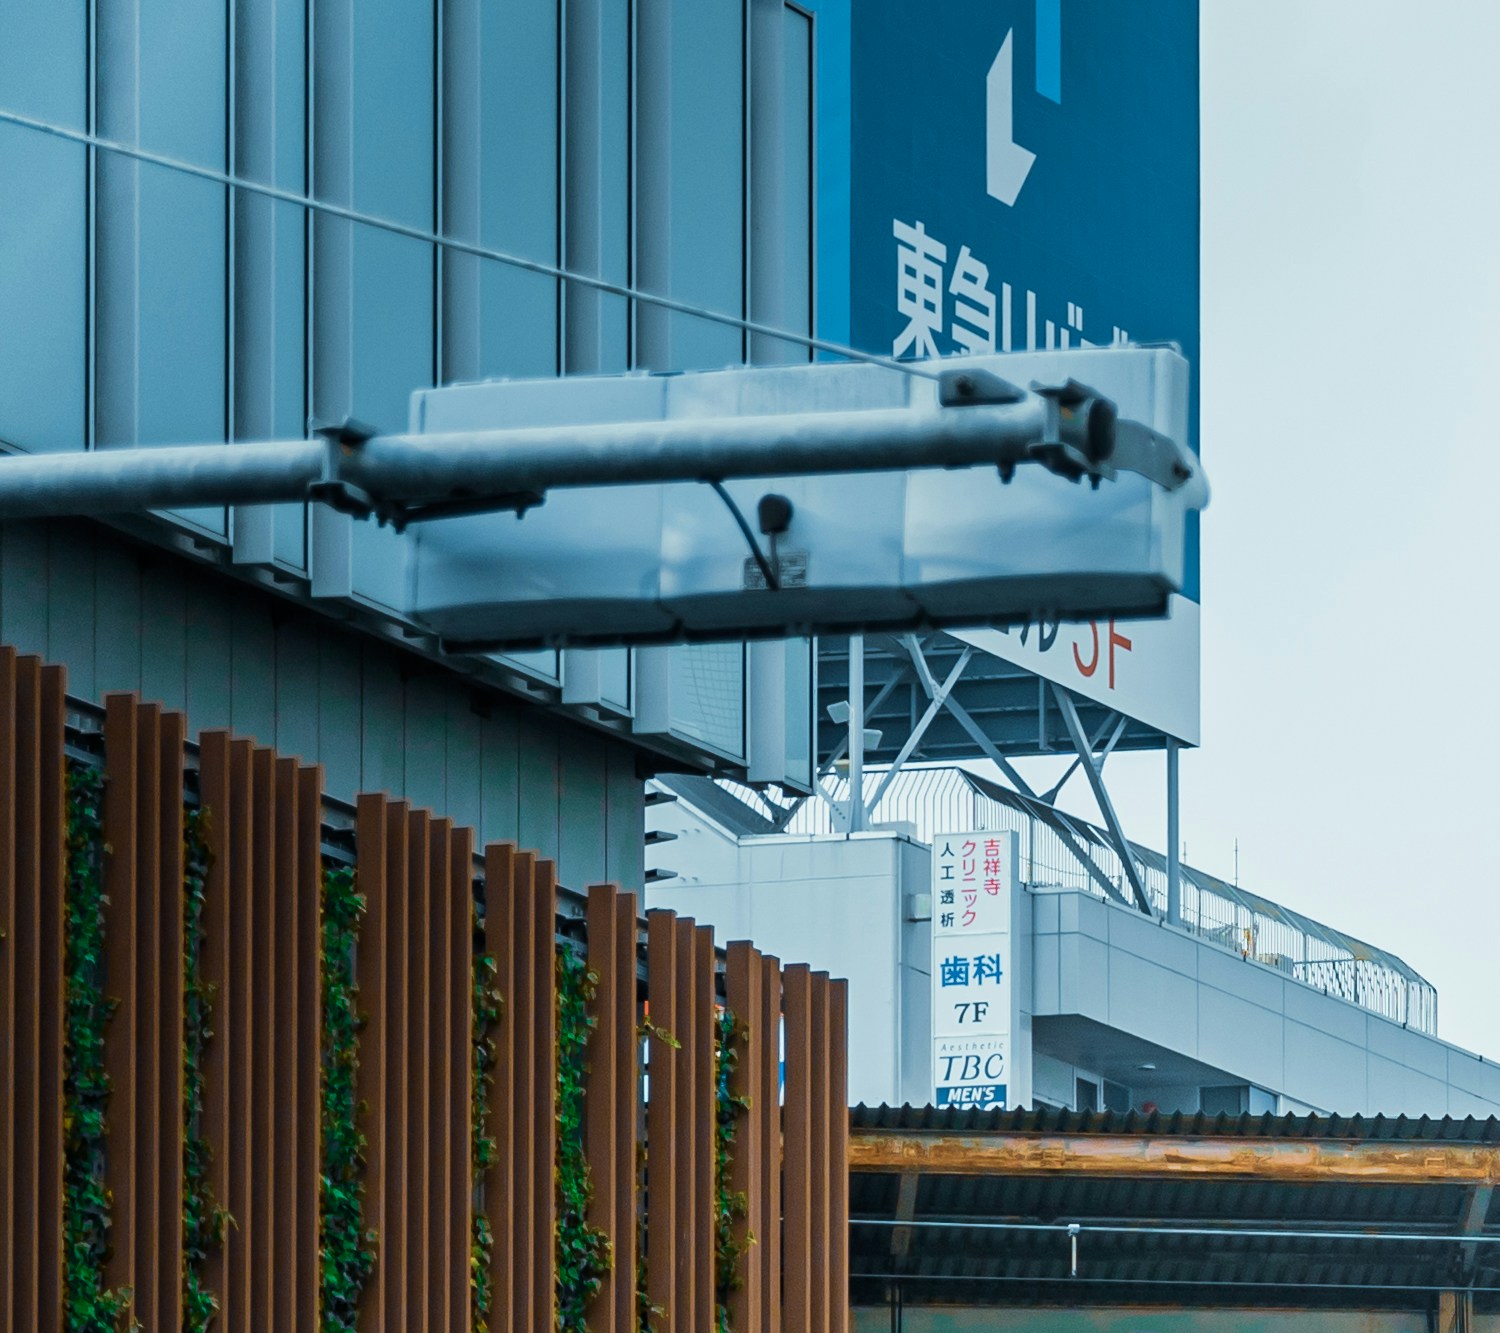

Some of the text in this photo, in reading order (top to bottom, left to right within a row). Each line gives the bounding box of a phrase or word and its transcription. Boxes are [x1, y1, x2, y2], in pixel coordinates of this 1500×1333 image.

[960, 839, 976, 927] クリニック
[983, 838, 1001, 896] 吉祥寺
[939, 841, 955, 928] 人工透析
[939, 953, 1003, 988] 歯科
[953, 1001, 989, 1024] 7F
[940, 1041, 1004, 1052] Aesthetic
[939, 1053, 1004, 1082] TBC
[947, 1085, 996, 1103] MEN'S
